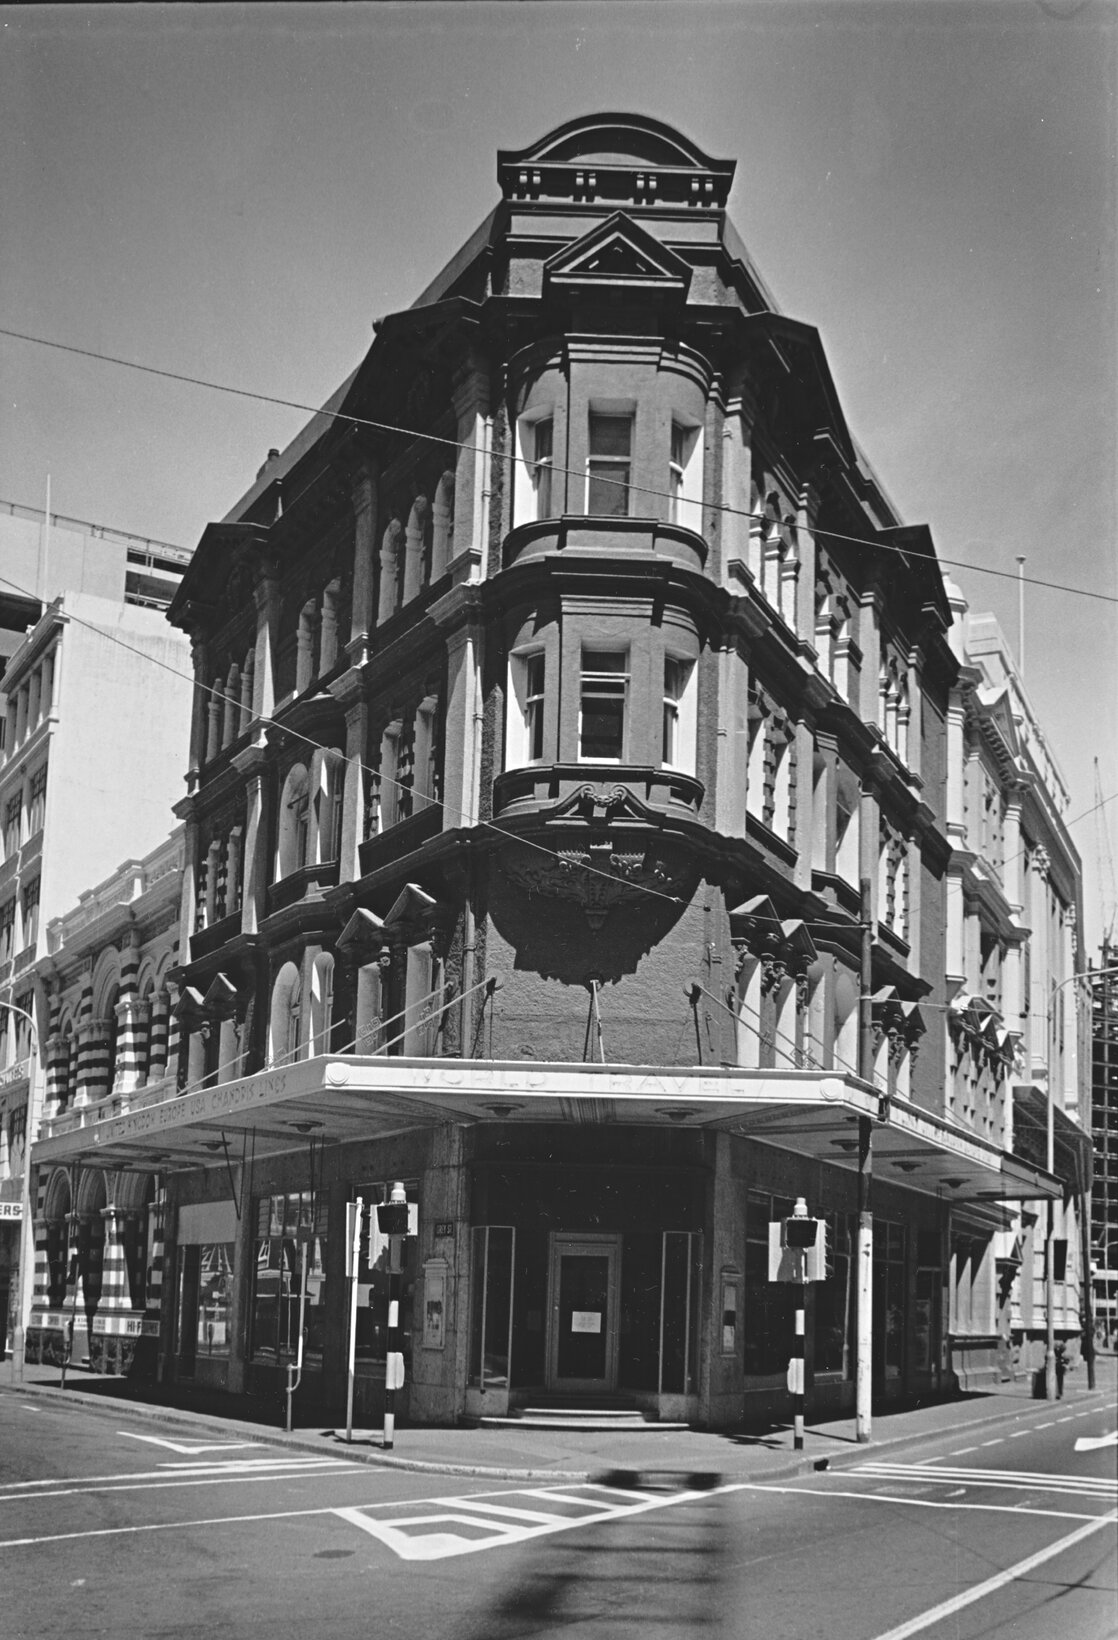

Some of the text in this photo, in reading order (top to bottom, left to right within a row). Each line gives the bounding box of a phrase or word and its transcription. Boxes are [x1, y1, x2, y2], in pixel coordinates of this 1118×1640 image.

[409, 1068, 746, 1093] WORLD TRAVEL
[160, 1103, 185, 1123] EUROPE
